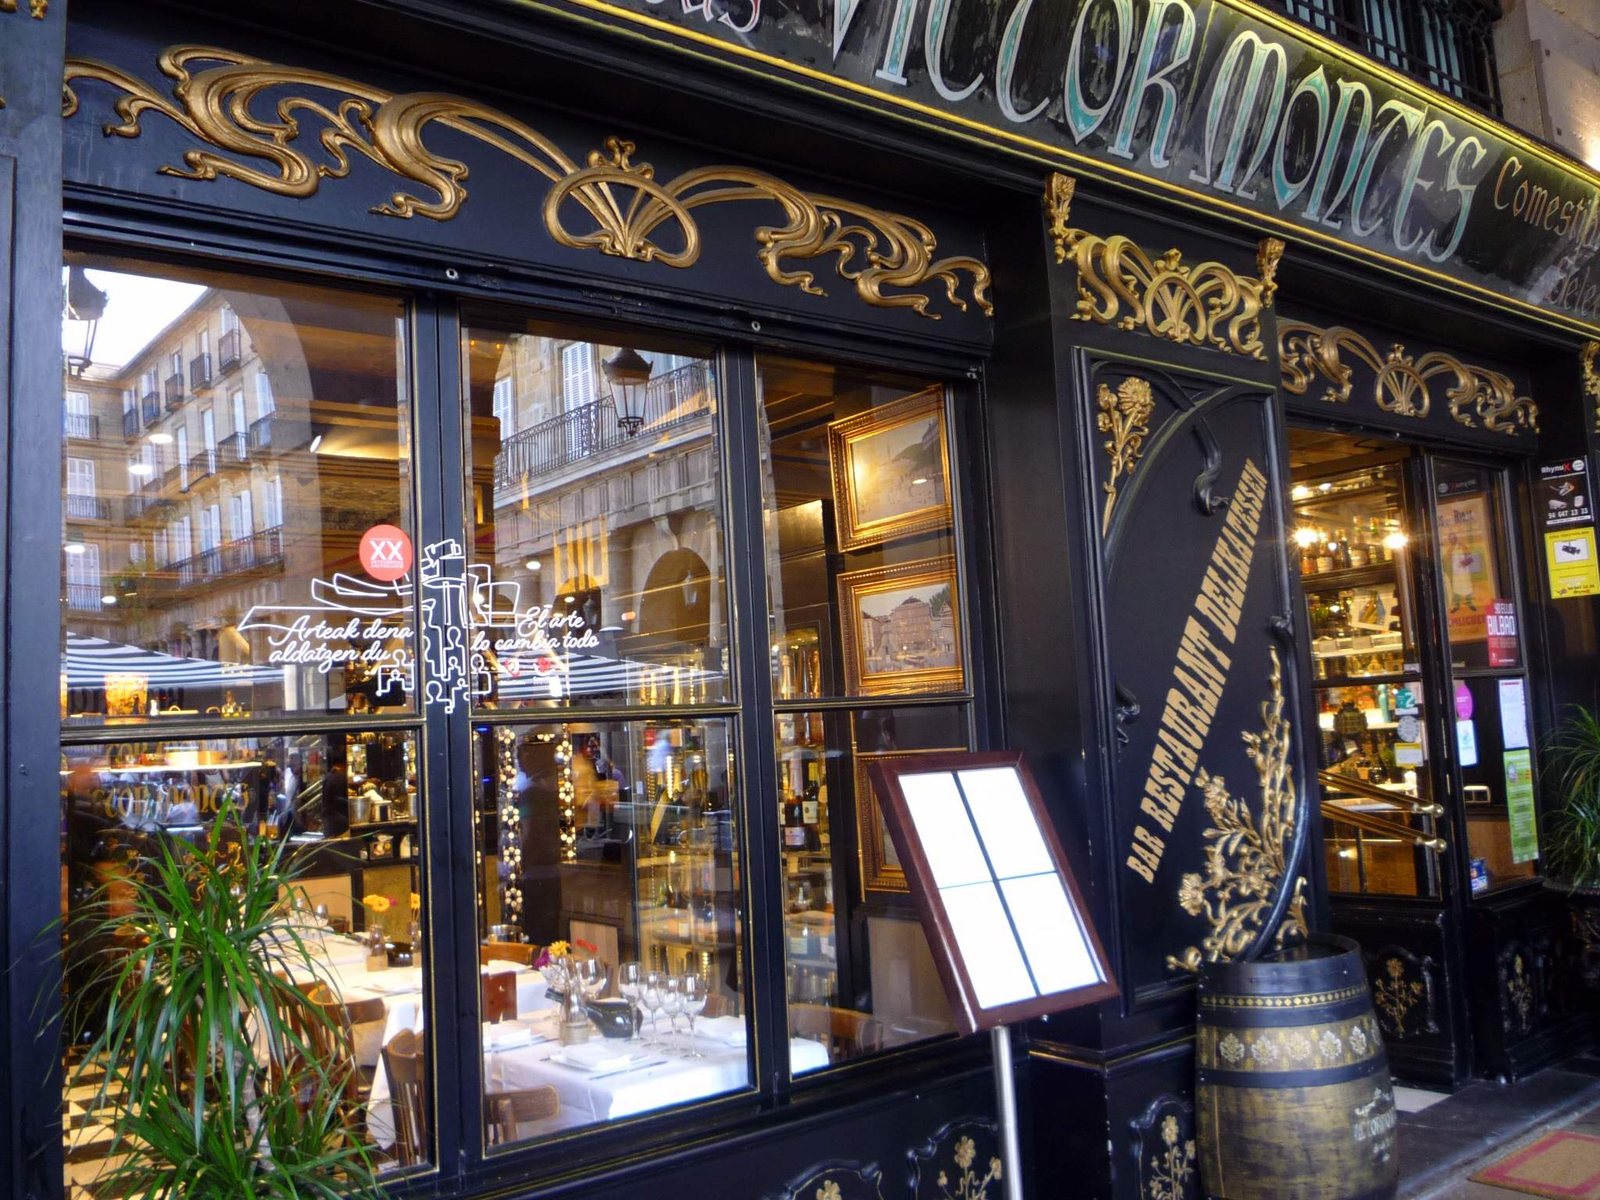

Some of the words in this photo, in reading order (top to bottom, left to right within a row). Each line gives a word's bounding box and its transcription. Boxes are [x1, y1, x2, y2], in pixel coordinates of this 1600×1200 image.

[1189, 29, 1487, 262] MONTES
[370, 540, 404, 560] XX
[1195, 457, 1269, 645] DELIKATESSEN
[268, 615, 360, 646] Arteak
[362, 618, 414, 639] dena
[517, 606, 549, 637] El
[549, 610, 585, 629] arte
[1486, 615, 1516, 636] BILBAO
[470, 631, 490, 651] lo
[494, 631, 560, 651] cambia
[562, 629, 600, 649] todo
[269, 640, 358, 673] aldatzen
[360, 640, 391, 661] du
[1140, 615, 1232, 833] RESTAURANT
[1126, 825, 1166, 885] BAR
